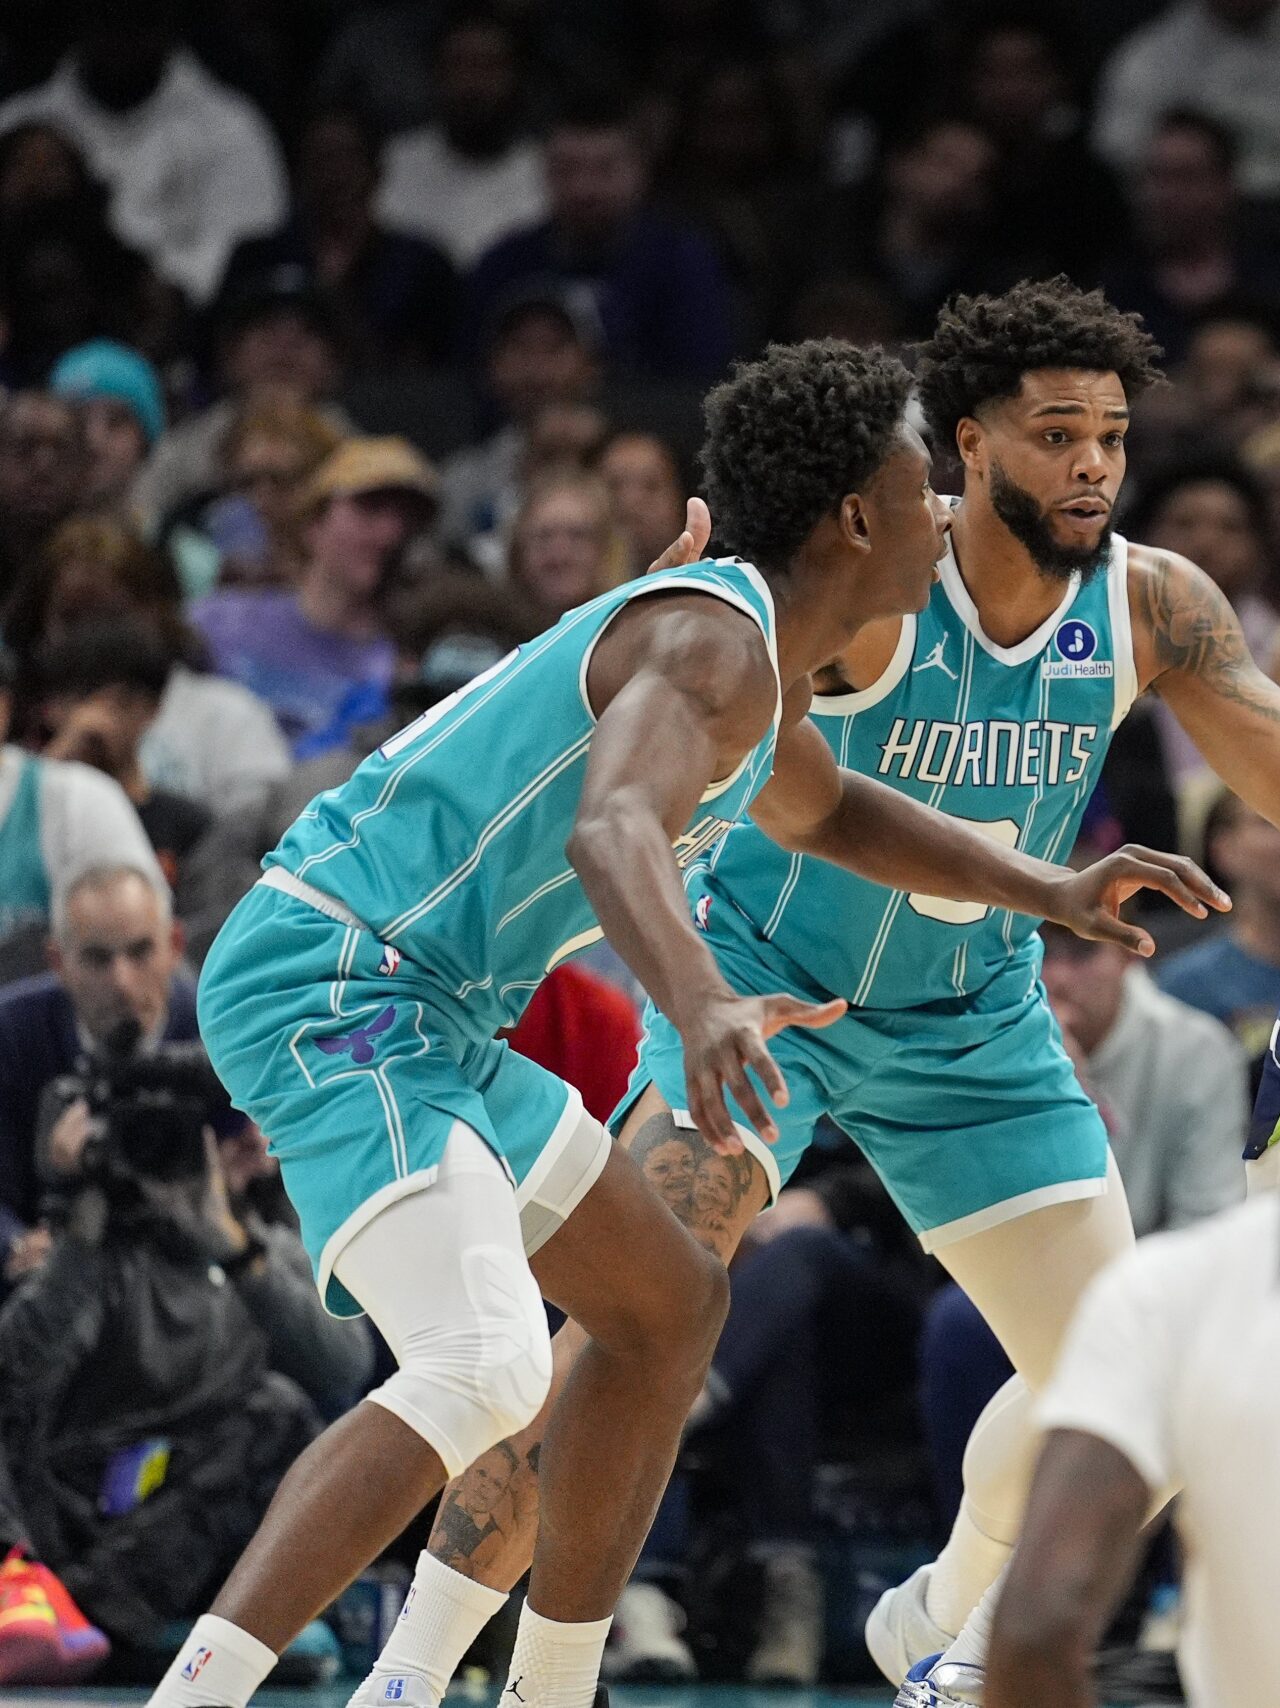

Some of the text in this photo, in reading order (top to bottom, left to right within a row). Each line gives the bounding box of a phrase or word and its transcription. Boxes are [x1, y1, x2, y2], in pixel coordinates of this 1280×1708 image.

[1045, 662, 1111, 676] Judi Health
[877, 717, 1098, 786] HORNETS
